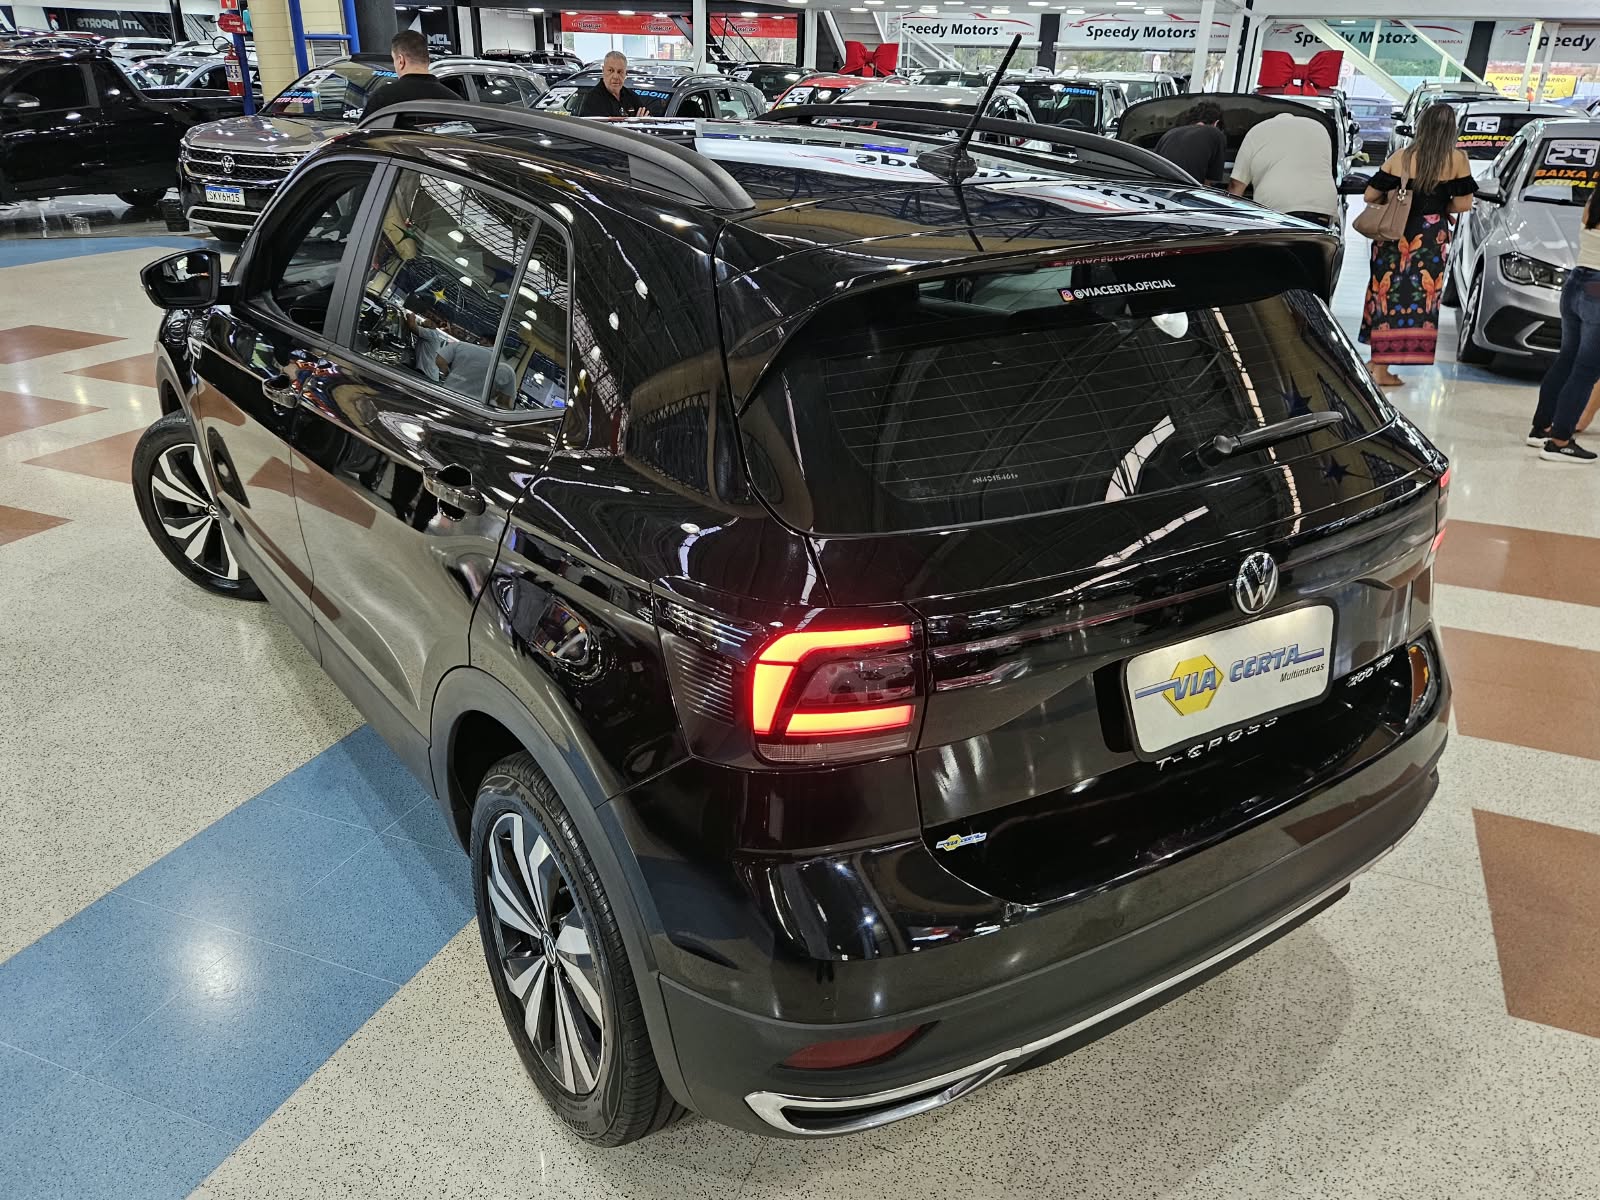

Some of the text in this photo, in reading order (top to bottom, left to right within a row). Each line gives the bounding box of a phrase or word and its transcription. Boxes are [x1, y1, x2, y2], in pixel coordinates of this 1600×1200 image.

[951, 23, 999, 36] Motors
[1086, 25, 1197, 41] Speedy Motors
[1294, 30, 1418, 47] Spey Motors
[1528, 34, 1596, 52] pedy
[371, 70, 398, 78] TURB
[633, 88, 670, 100] RBO!!!
[1457, 134, 1513, 142] COMPLETO
[1547, 146, 1595, 165] 24
[1534, 169, 1587, 178] BAIXA
[1533, 178, 1598, 188] COMPLE
[1073, 279, 1176, 299] @VIACERTA.OFICIAL
[1172, 643, 1300, 702] VIA CERTA
[1279, 662, 1325, 683] Multimarcas
